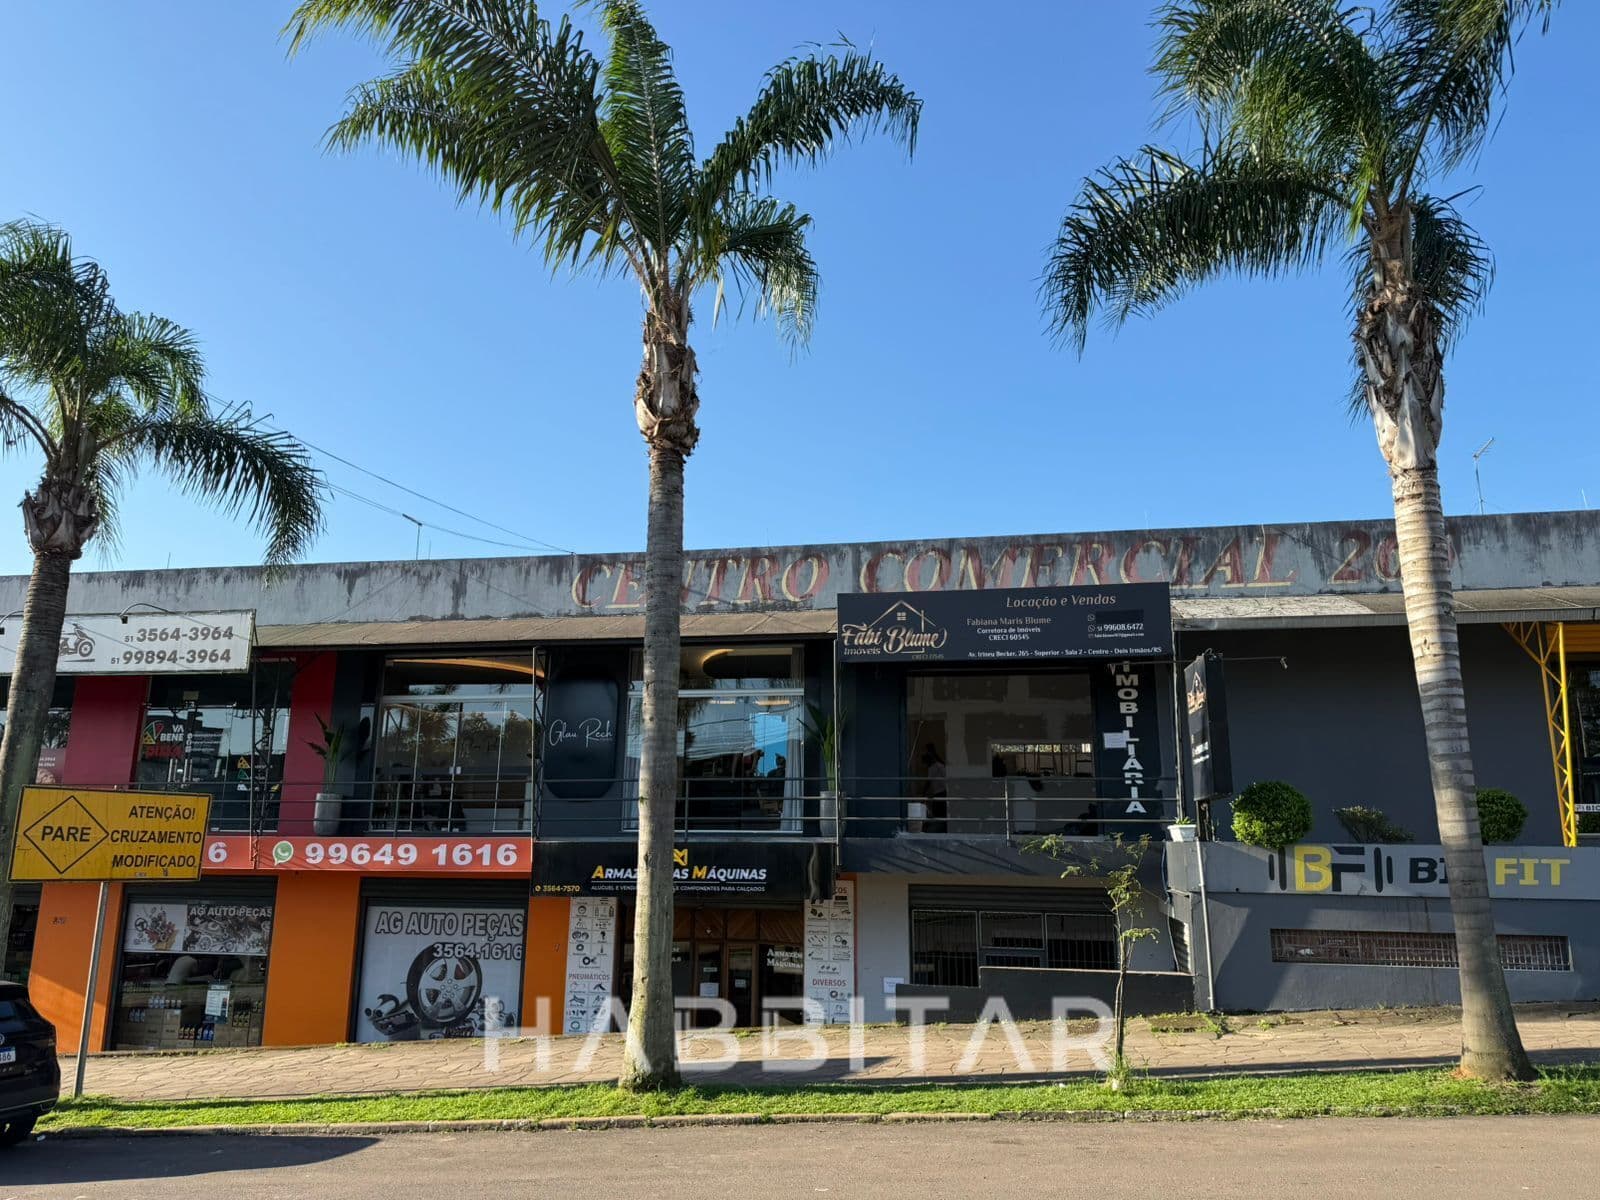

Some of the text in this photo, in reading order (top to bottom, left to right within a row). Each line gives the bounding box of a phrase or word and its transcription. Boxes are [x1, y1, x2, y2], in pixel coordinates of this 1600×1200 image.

[859, 532, 1299, 593] COMERCIAL
[1006, 594, 1116, 609] Locação e Vendas
[967, 616, 1052, 626] Fabiana Maris Blume
[137, 626, 234, 643] 3564-3964
[841, 622, 947, 654] Fabi Blume
[122, 649, 231, 664] 99894-3964
[844, 646, 881, 655] Imóveis
[172, 724, 184, 732] VA
[578, 718, 613, 748] Rech
[160, 733, 184, 741] BENE
[1116, 660, 1148, 814] IMOBILIÁRIA
[128, 804, 196, 822] ATENÇÃO!
[41, 825, 91, 843] PARE
[110, 829, 202, 844] CRUZAMENTO
[207, 841, 228, 863] 6
[304, 842, 518, 867] 99649 1616
[111, 853, 196, 868] MODIFICADO
[591, 865, 767, 881] ARMAZ AS MÁQUINAS
[1495, 858, 1571, 886] FIT
[542, 884, 581, 892] 3564-7570
[189, 905, 272, 920] AG AUTO PEÇAS
[375, 911, 524, 941] AG AUTO PEÇAS
[432, 941, 522, 961] 3564.1616
[568, 972, 610, 982] PNEUMÁTICOS
[812, 978, 847, 987] DIVERSOS
